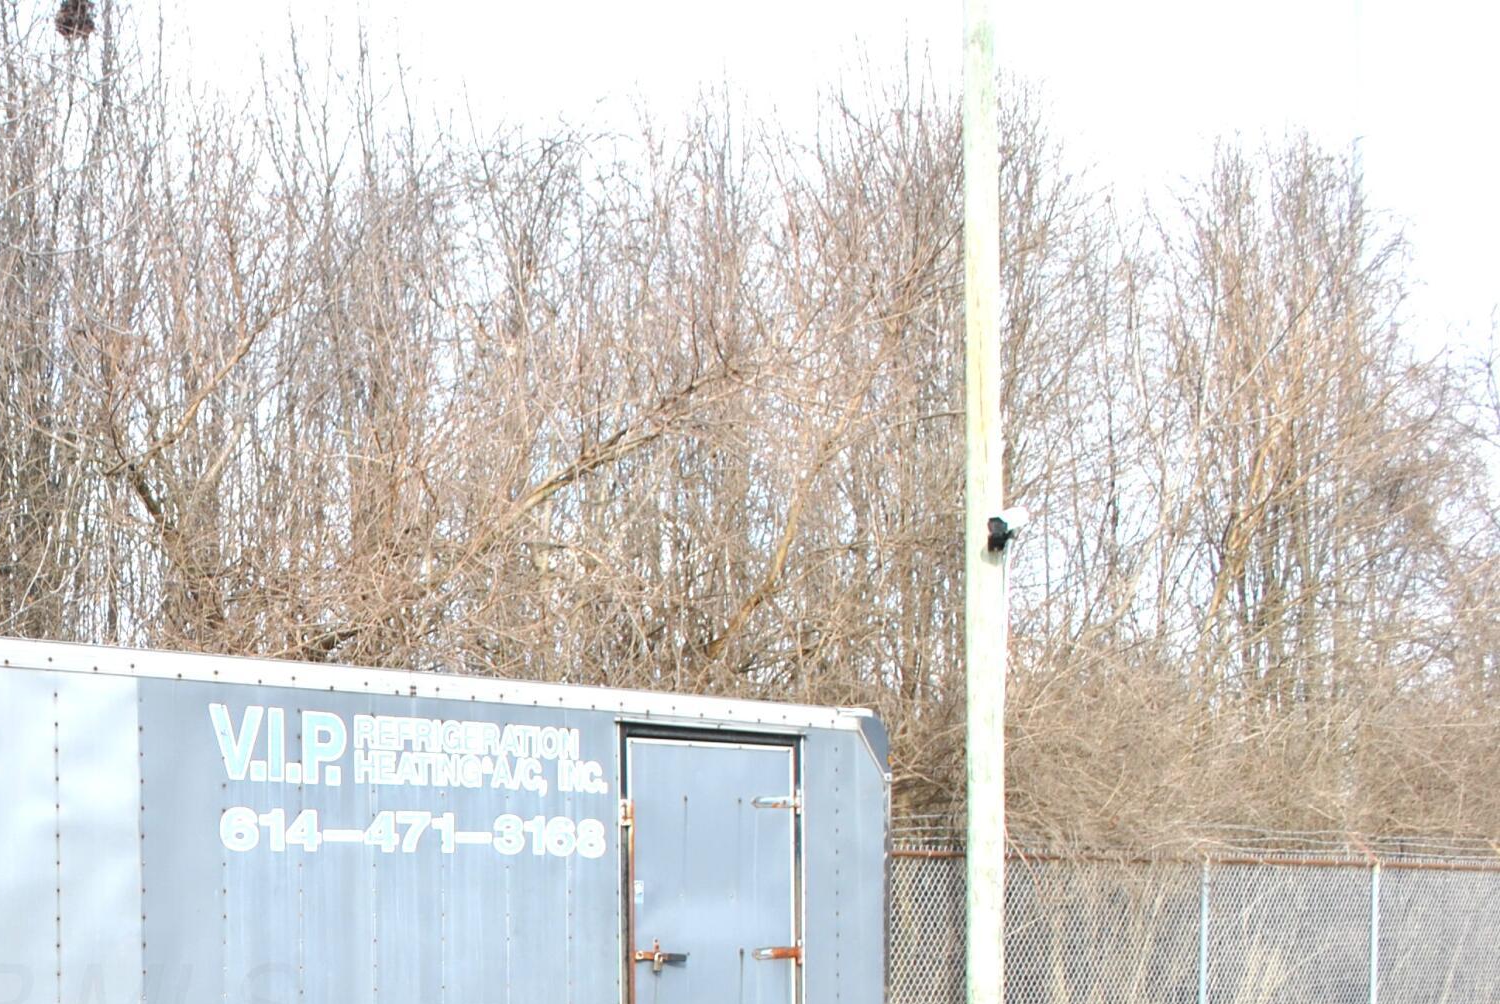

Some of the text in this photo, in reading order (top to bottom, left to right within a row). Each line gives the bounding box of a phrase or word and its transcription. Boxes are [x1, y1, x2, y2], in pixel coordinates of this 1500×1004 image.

[209, 703, 348, 787] V.I.P.
[354, 714, 580, 761] REFRIGERATION
[557, 759, 609, 795] INC.
